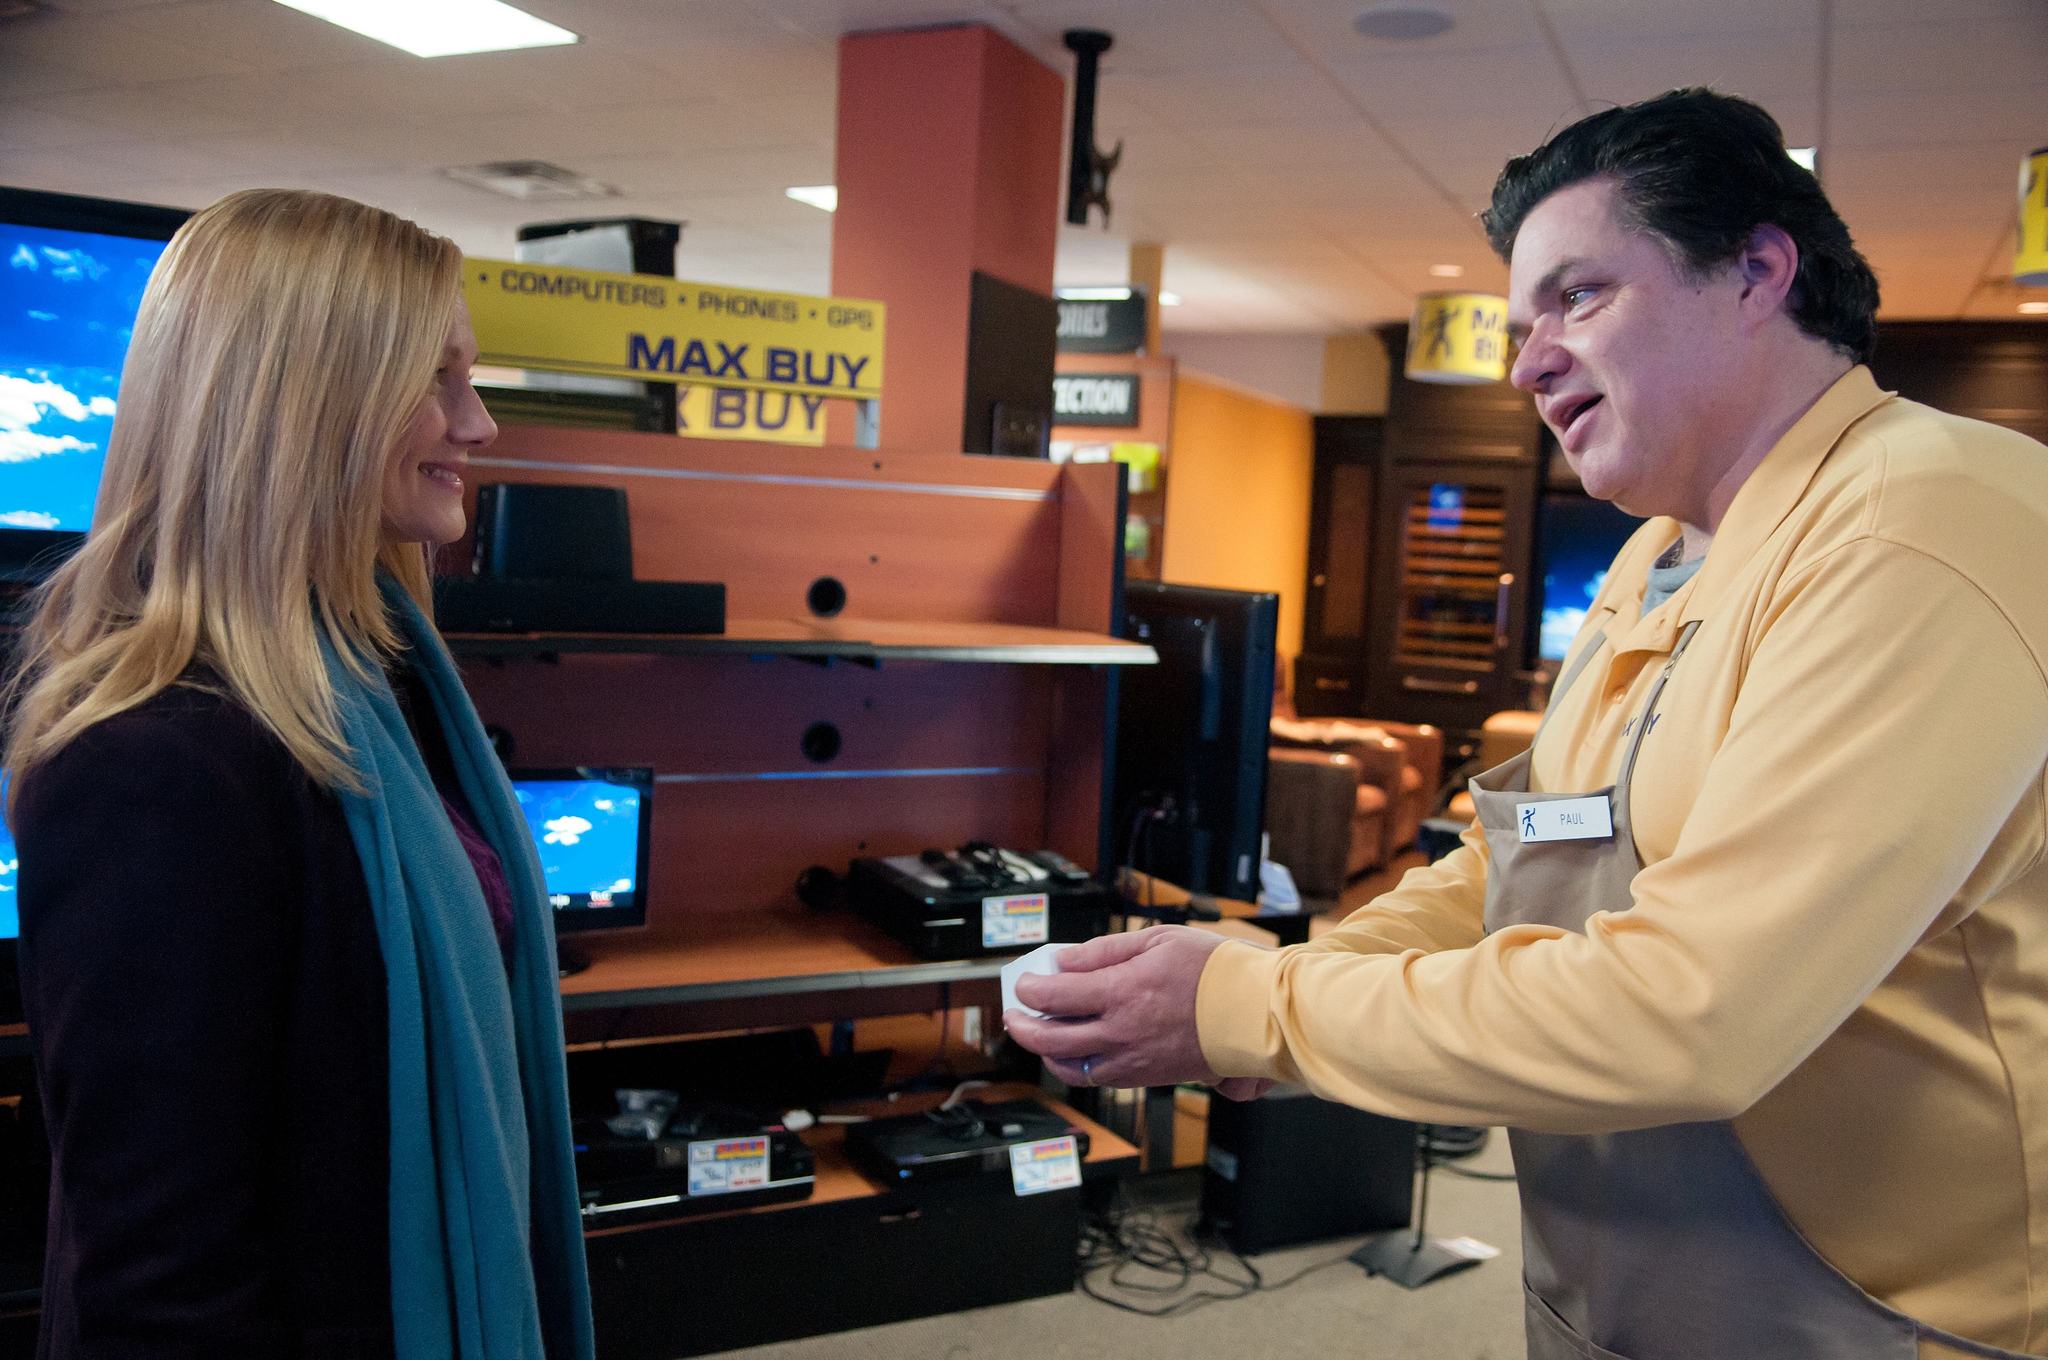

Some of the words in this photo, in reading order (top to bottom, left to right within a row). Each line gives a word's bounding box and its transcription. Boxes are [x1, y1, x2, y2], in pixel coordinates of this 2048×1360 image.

[502, 268, 666, 308] COMPUTERS
[698, 291, 798, 322] PHONES
[827, 305, 873, 329] GPS
[629, 333, 749, 380] MAX
[765, 347, 870, 388] BUY
[712, 386, 823, 431] BUY
[1560, 813, 1585, 825] PAUL
